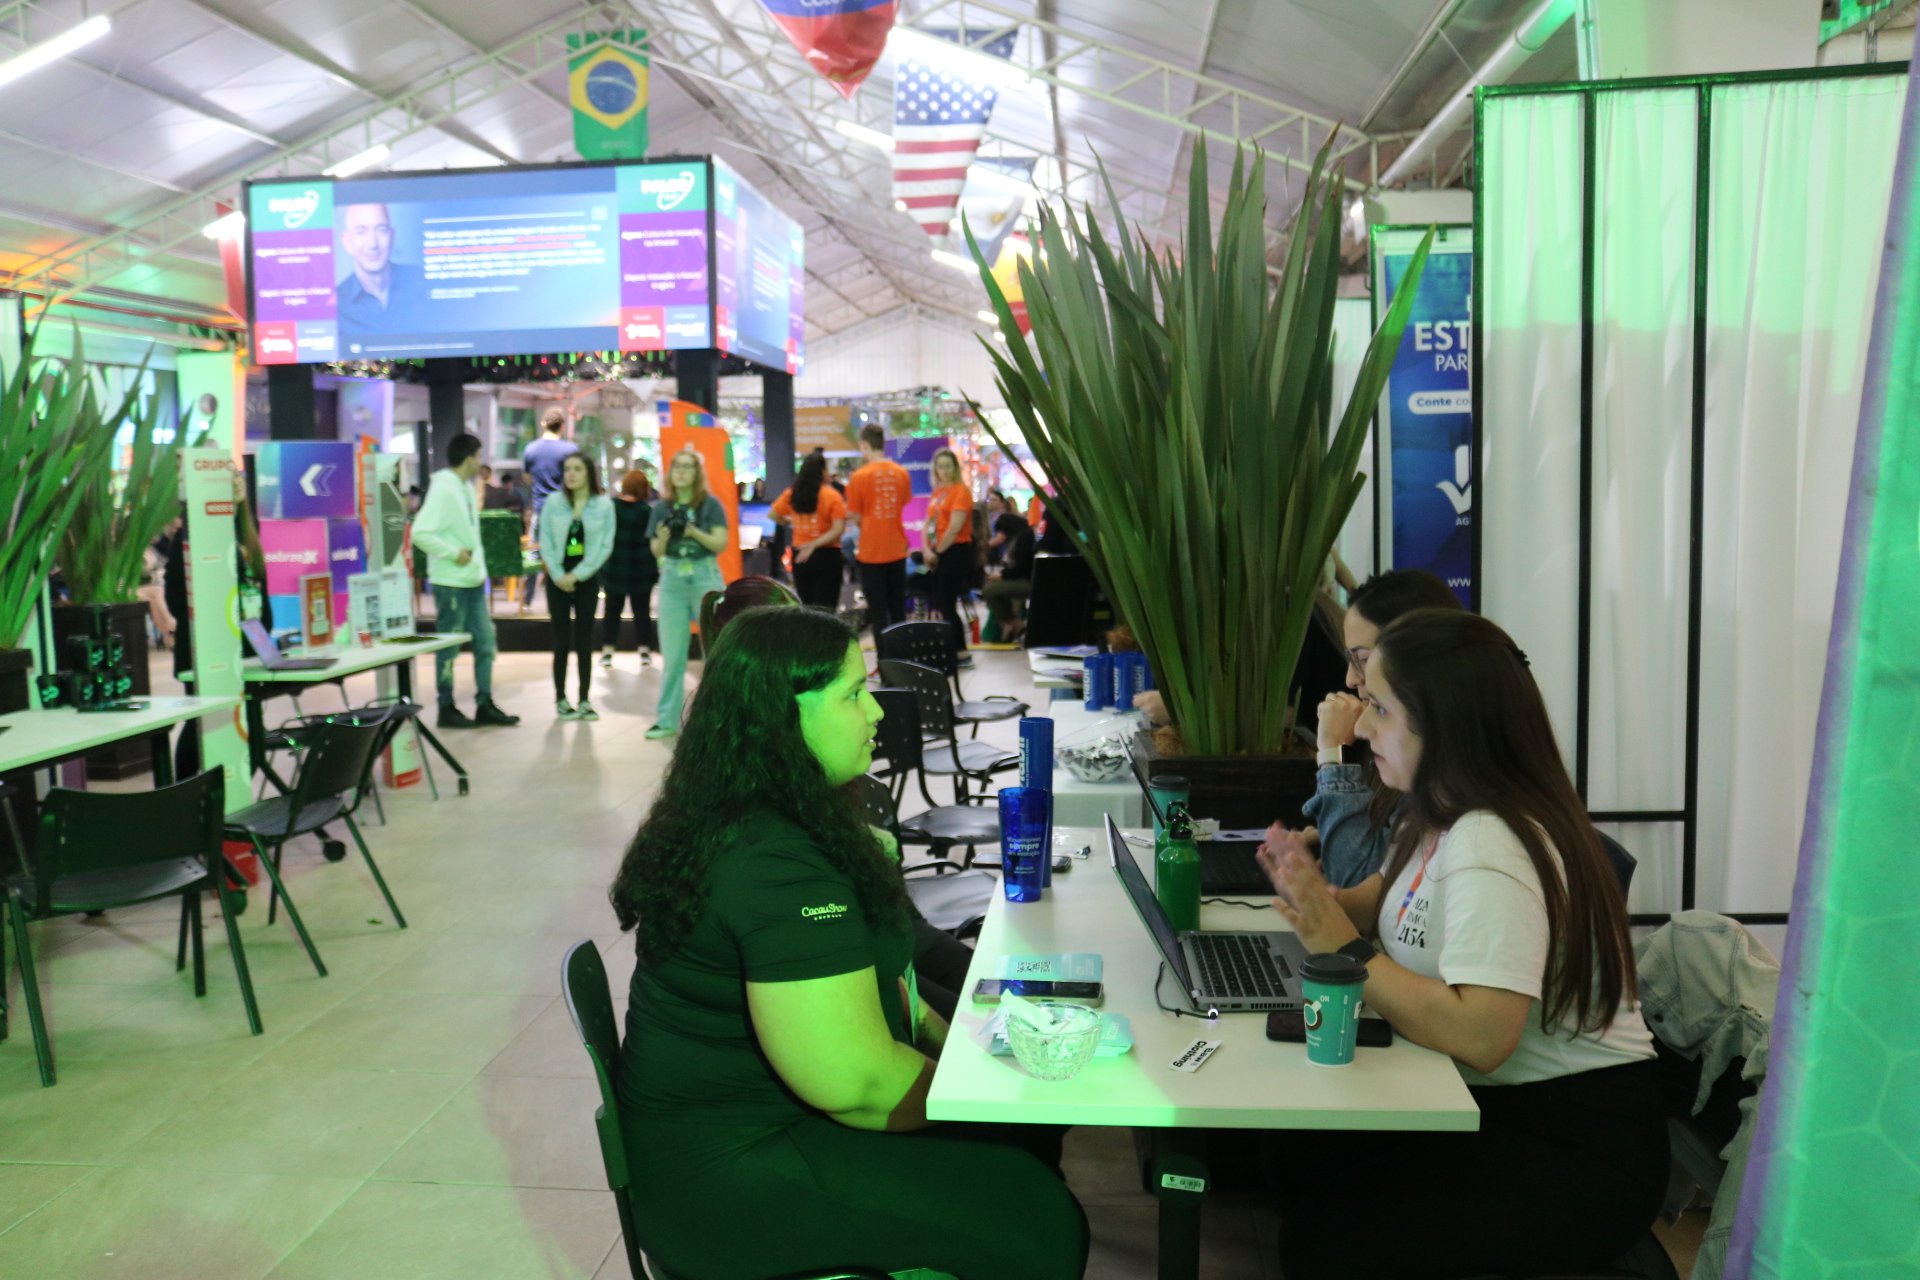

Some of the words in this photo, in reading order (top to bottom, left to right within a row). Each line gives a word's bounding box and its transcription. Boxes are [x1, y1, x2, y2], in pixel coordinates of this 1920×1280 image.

[1415, 320, 1470, 351] EST
[1435, 353, 1468, 371] PAR
[1416, 397, 1452, 407] Conte
[194, 459, 237, 472] GRUPO
[1172, 1041, 1207, 1068] Clothing
